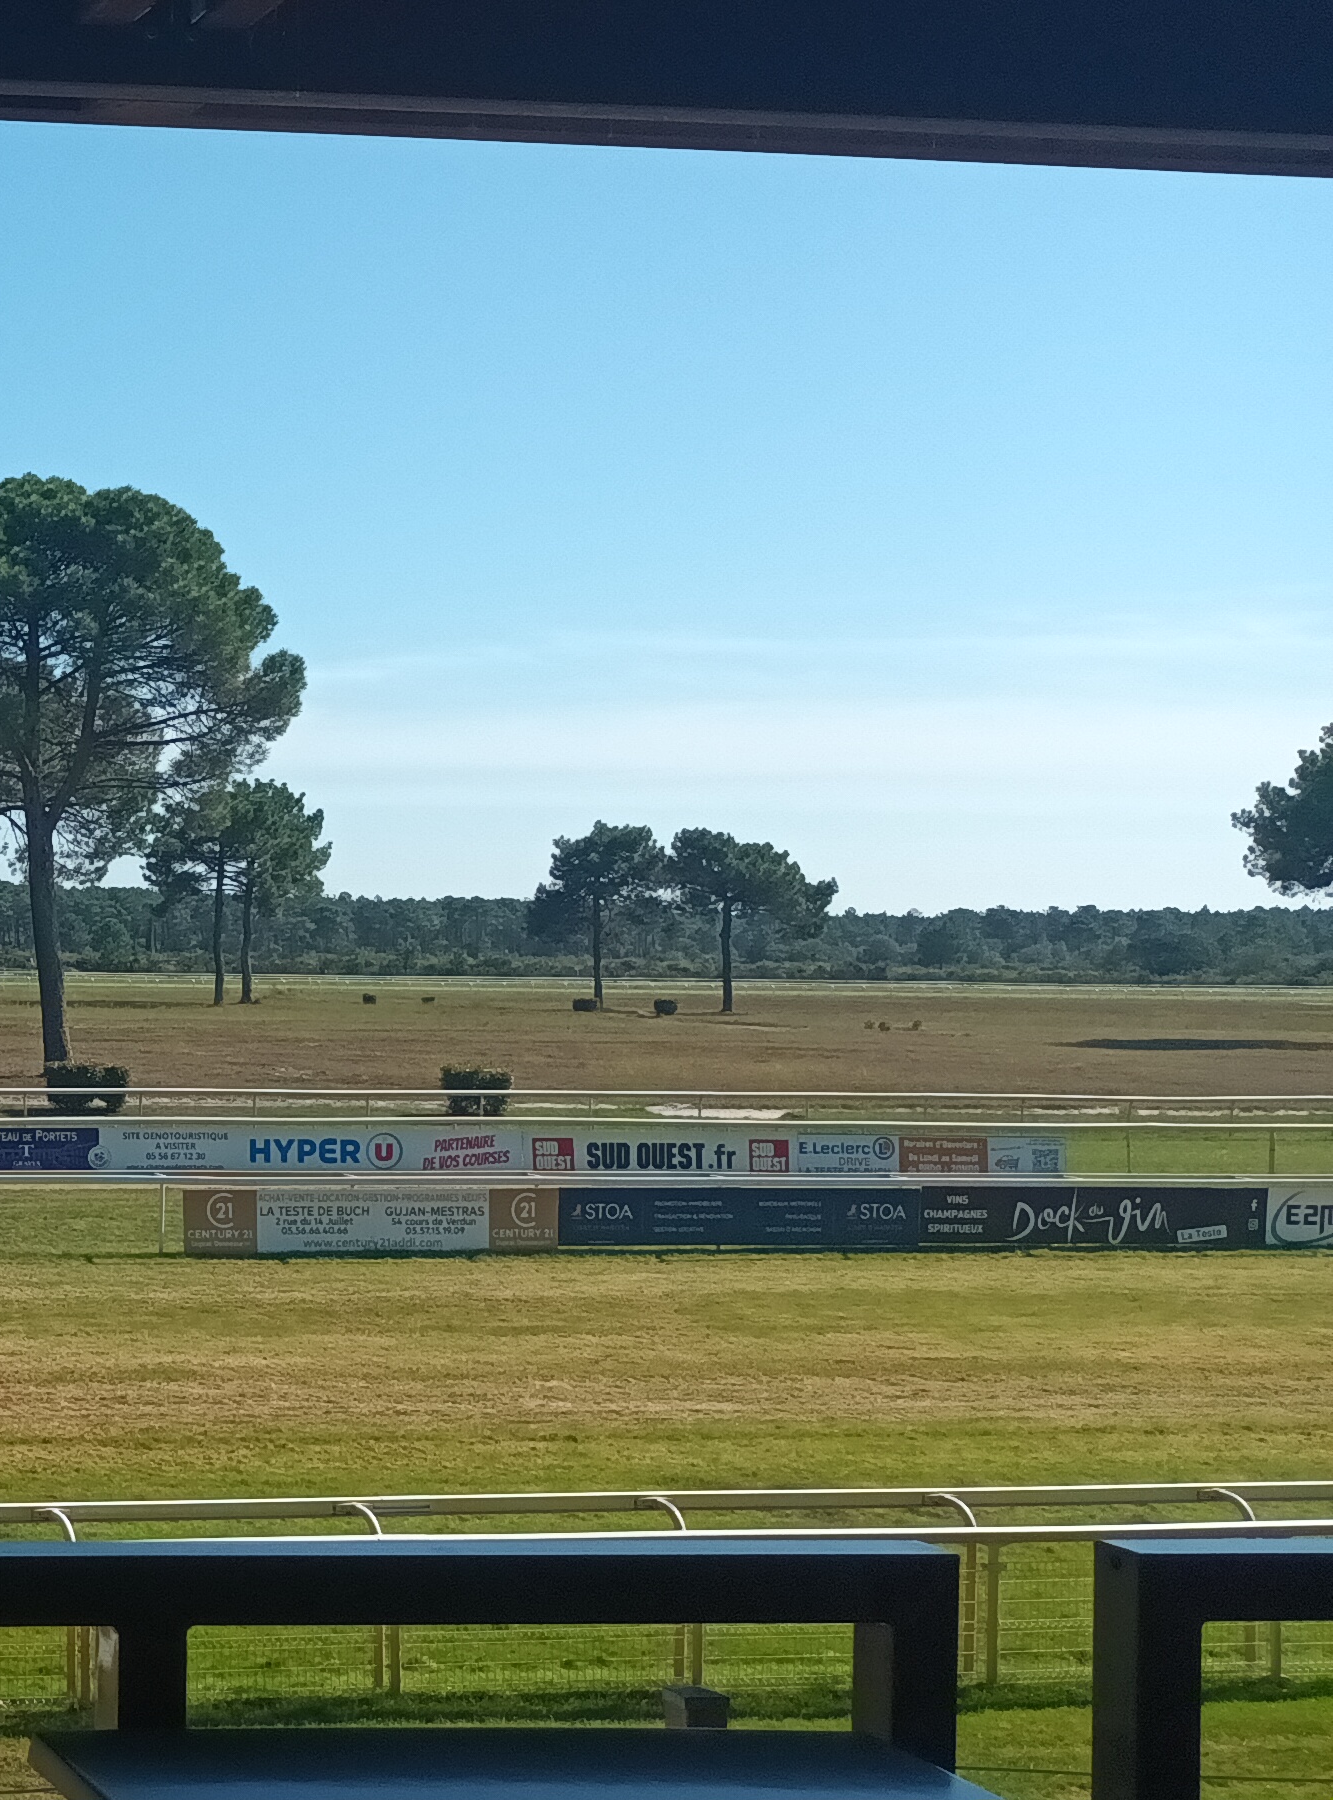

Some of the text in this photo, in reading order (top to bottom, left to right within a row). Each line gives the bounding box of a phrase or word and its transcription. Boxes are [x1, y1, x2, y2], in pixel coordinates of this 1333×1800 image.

[122, 1132, 140, 1140] SITE
[155, 1142, 196, 1150] A VISITER
[434, 1135, 496, 1152] PARTENAIRE
[535, 1141, 558, 1155] SUD
[751, 1142, 774, 1156] SUD
[799, 1142, 871, 1155] E.Leclerc
[183, 1152, 193, 1160] 12
[249, 1138, 393, 1164] HYPER U
[586, 1142, 630, 1169] SUD
[422, 1150, 510, 1170] DE VOS COURSES
[536, 1155, 572, 1170] OUEST
[752, 1157, 787, 1171] OUEST
[838, 1157, 871, 1166] DRIVE
[947, 1195, 969, 1204] VINS
[259, 1206, 370, 1216] LA TESTE DE BUCH
[385, 1205, 485, 1217] GUJAN-MESTRAS
[585, 1203, 633, 1220] STOA
[859, 1203, 907, 1220] STOA
[924, 1209, 988, 1219] CHAMPAGNES
[1089, 1202, 1103, 1215] du
[276, 1217, 353, 1226] 2 rue du 14 Juillet
[405, 1218, 429, 1226] cours
[432, 1217, 443, 1225] de
[445, 1217, 476, 1225] Verdun
[188, 1230, 253, 1238] CENTURY 21
[492, 1228, 554, 1237] CENTURY 21
[928, 1223, 983, 1233] SPIRITUEUX
[1180, 1227, 1223, 1239] La Teste
